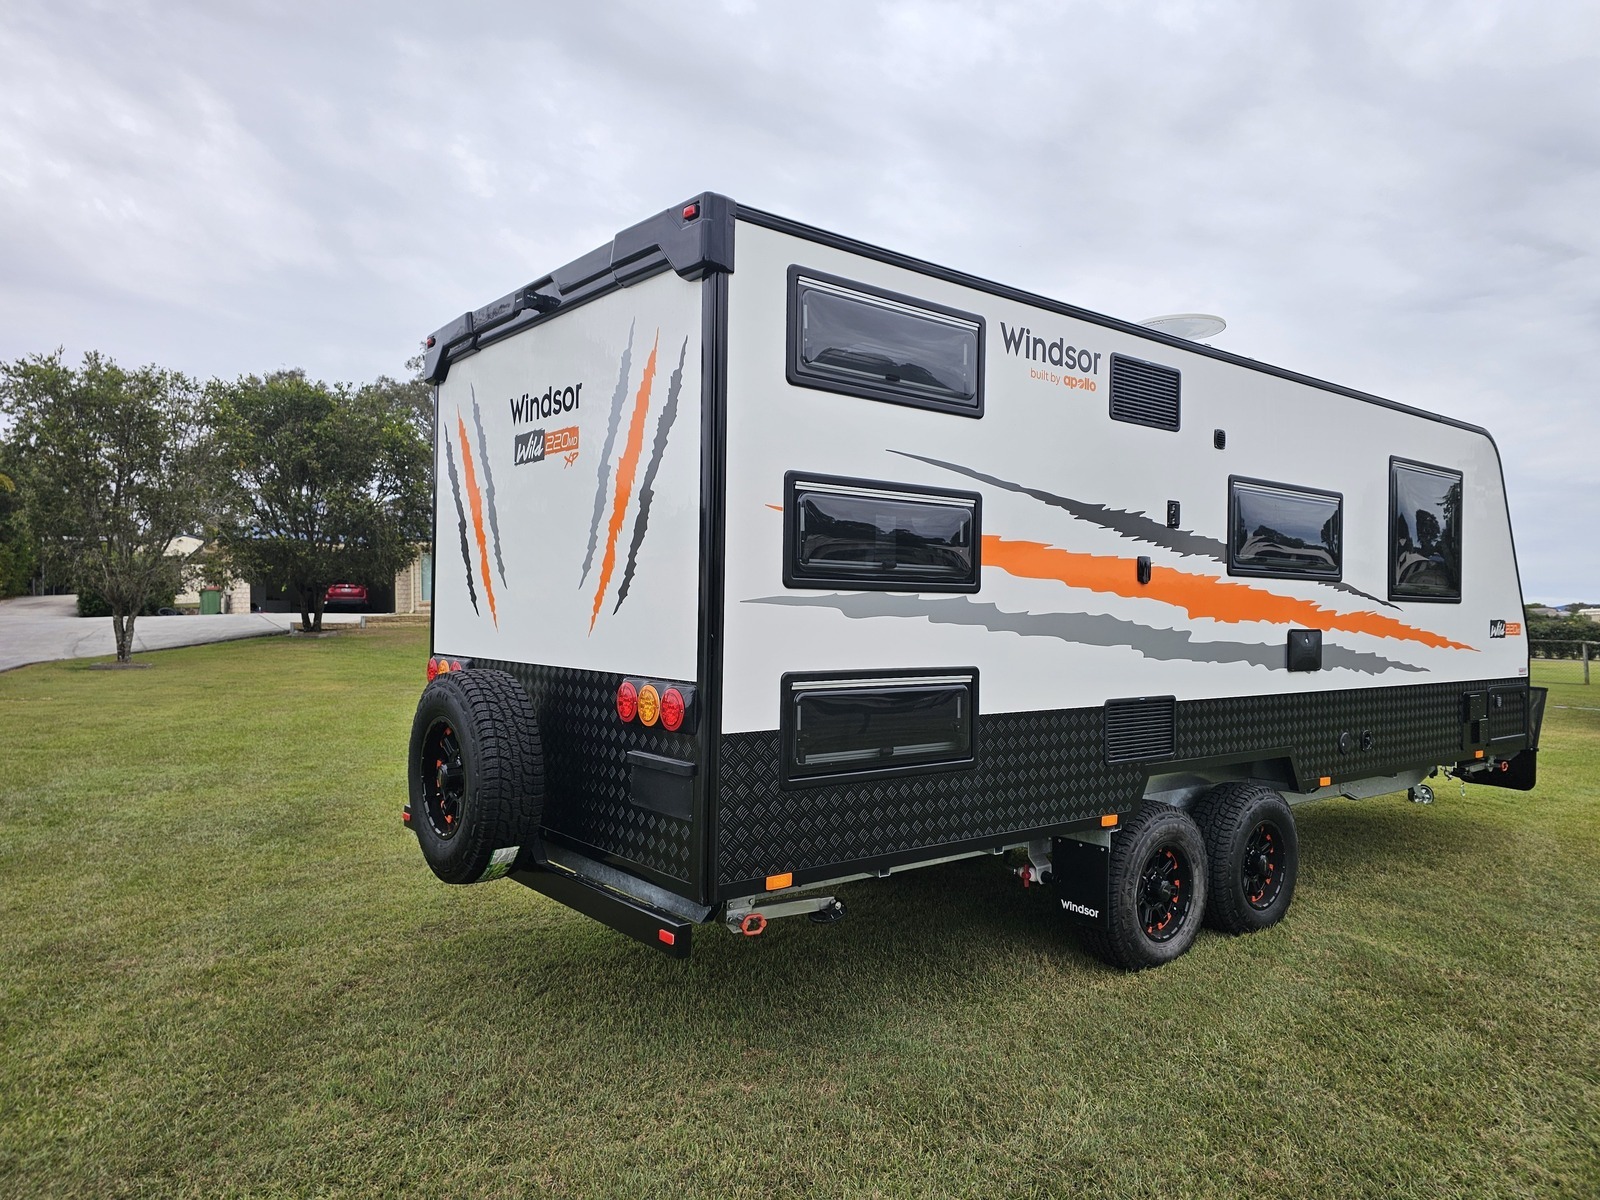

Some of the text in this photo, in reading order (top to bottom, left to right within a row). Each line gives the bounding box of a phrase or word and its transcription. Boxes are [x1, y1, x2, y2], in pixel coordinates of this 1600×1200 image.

[1000, 321, 1102, 375] Windsor
[1030, 367, 1097, 392] built by apollo
[510, 382, 583, 427] Windsor
[516, 433, 544, 463] Wild
[1061, 898, 1100, 918] Windsor
